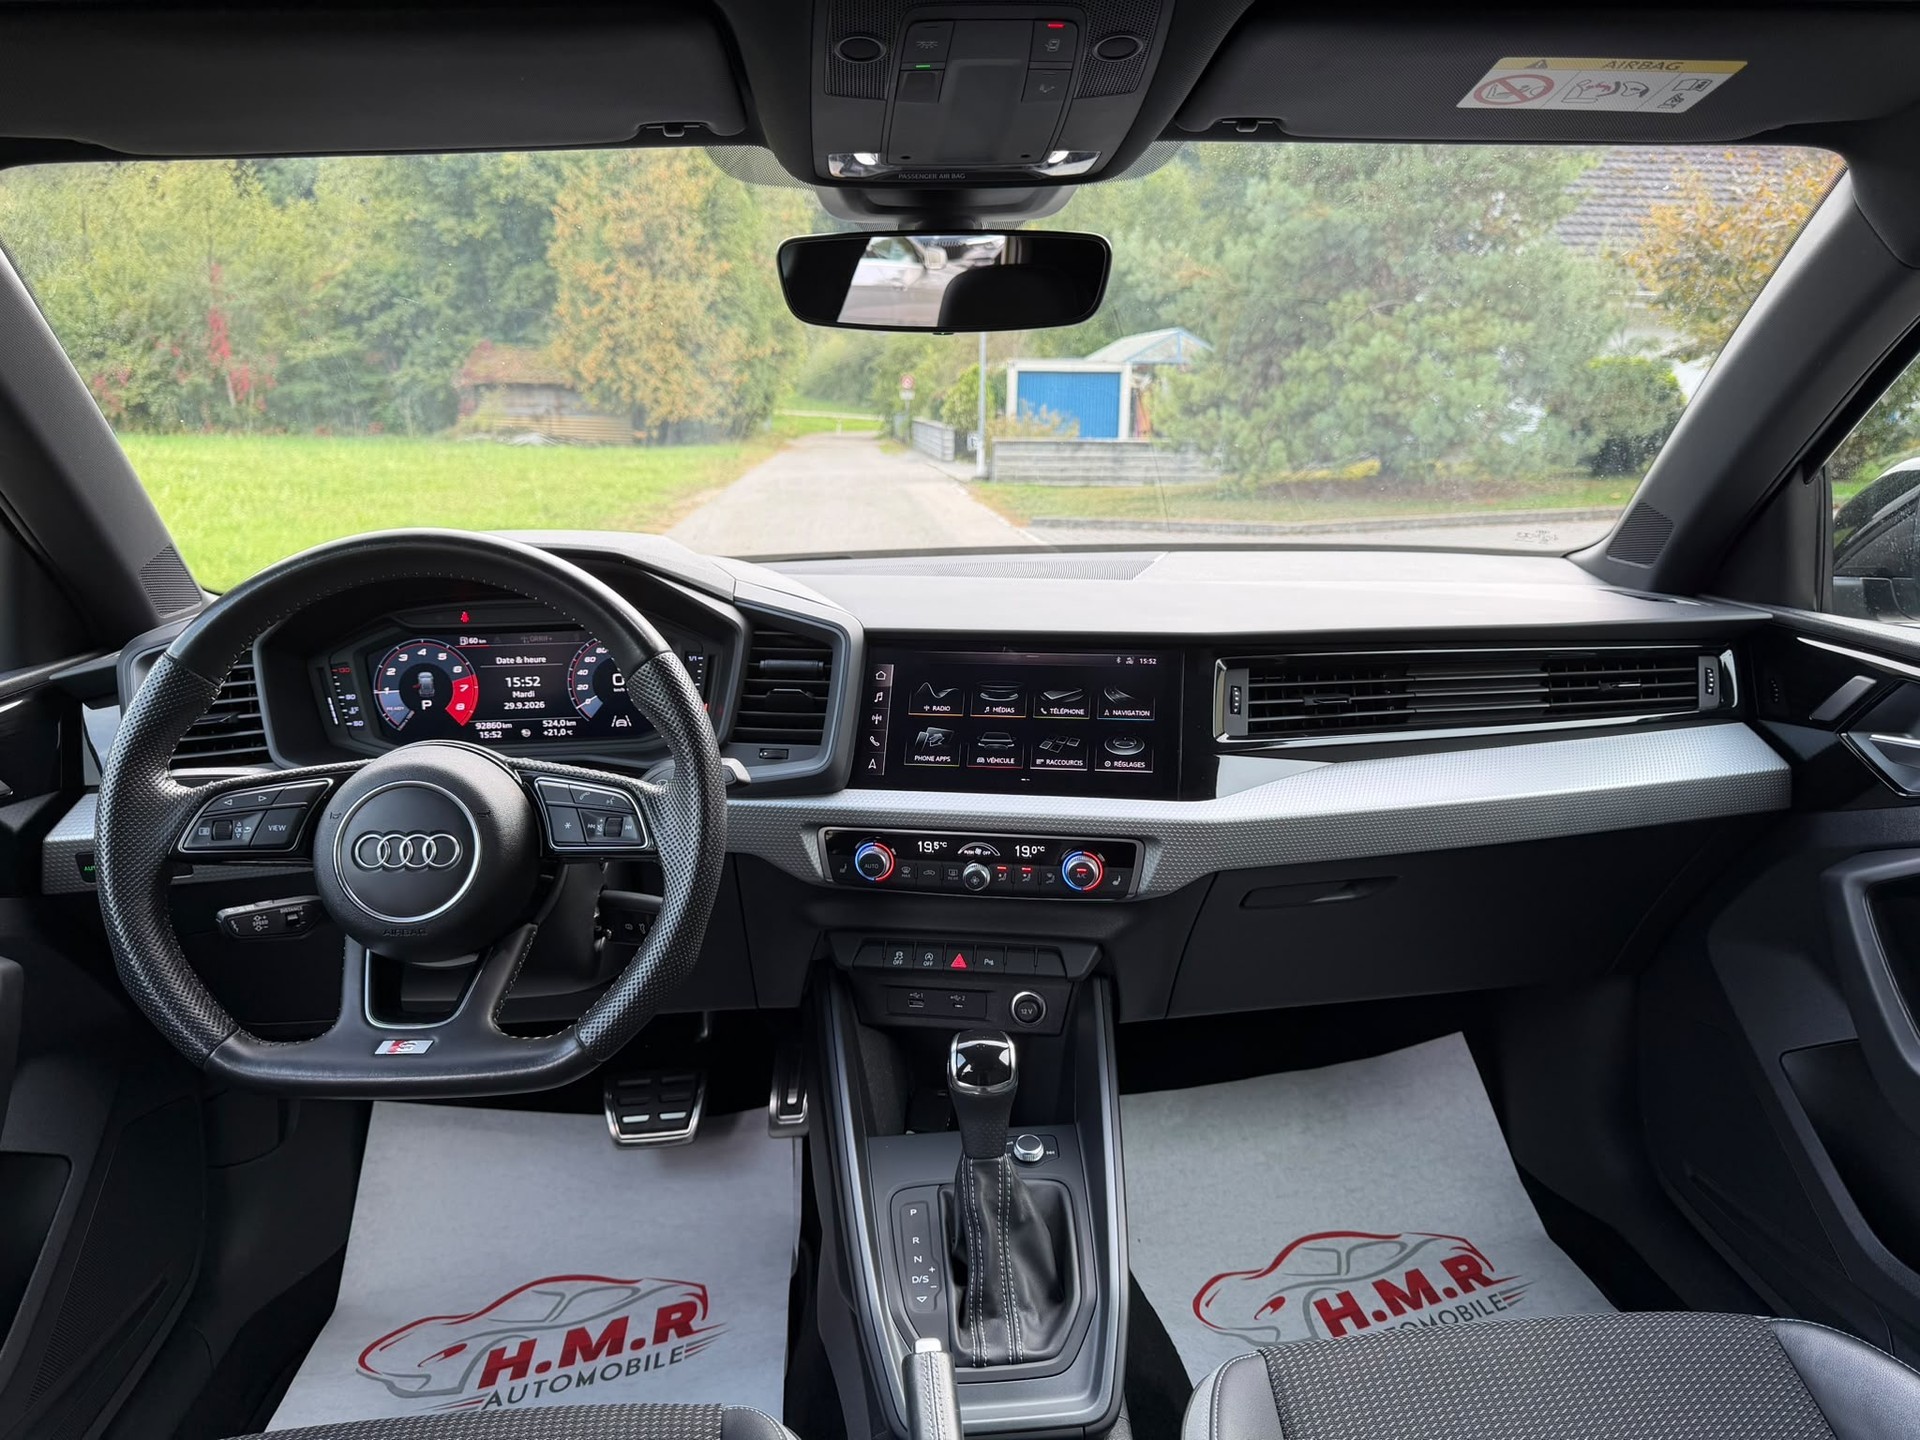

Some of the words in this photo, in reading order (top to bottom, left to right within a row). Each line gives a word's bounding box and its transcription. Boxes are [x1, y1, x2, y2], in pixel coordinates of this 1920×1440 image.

[1603, 61, 1684, 71] AIRBAG
[417, 648, 427, 656] 4
[398, 653, 409, 662] 3
[437, 652, 447, 661] 5
[386, 667, 397, 676] 2
[452, 665, 462, 674] 6
[505, 676, 541, 688] 15:52
[459, 684, 470, 692] 7
[421, 700, 433, 711] P
[455, 703, 466, 711] 8
[504, 701, 546, 710] 29.9.2026
[1050, 707, 1085, 715] TÉLÉPHONE
[475, 722, 502, 730] 92860
[542, 720, 566, 728] 524,0
[479, 731, 503, 739] 15:52
[543, 729, 567, 737] +21,0
[1046, 759, 1083, 767] RACCOURCIS
[1113, 761, 1146, 769] RÉGLAGES
[910, 1208, 917, 1216] P
[912, 1236, 920, 1244] R
[913, 1255, 923, 1263] N
[911, 1275, 930, 1284] D/S
[1313, 1254, 1495, 1338] H.M.R
[478, 1301, 698, 1390] H.M.R
[482, 1345, 686, 1411] AUTOMOBILE
